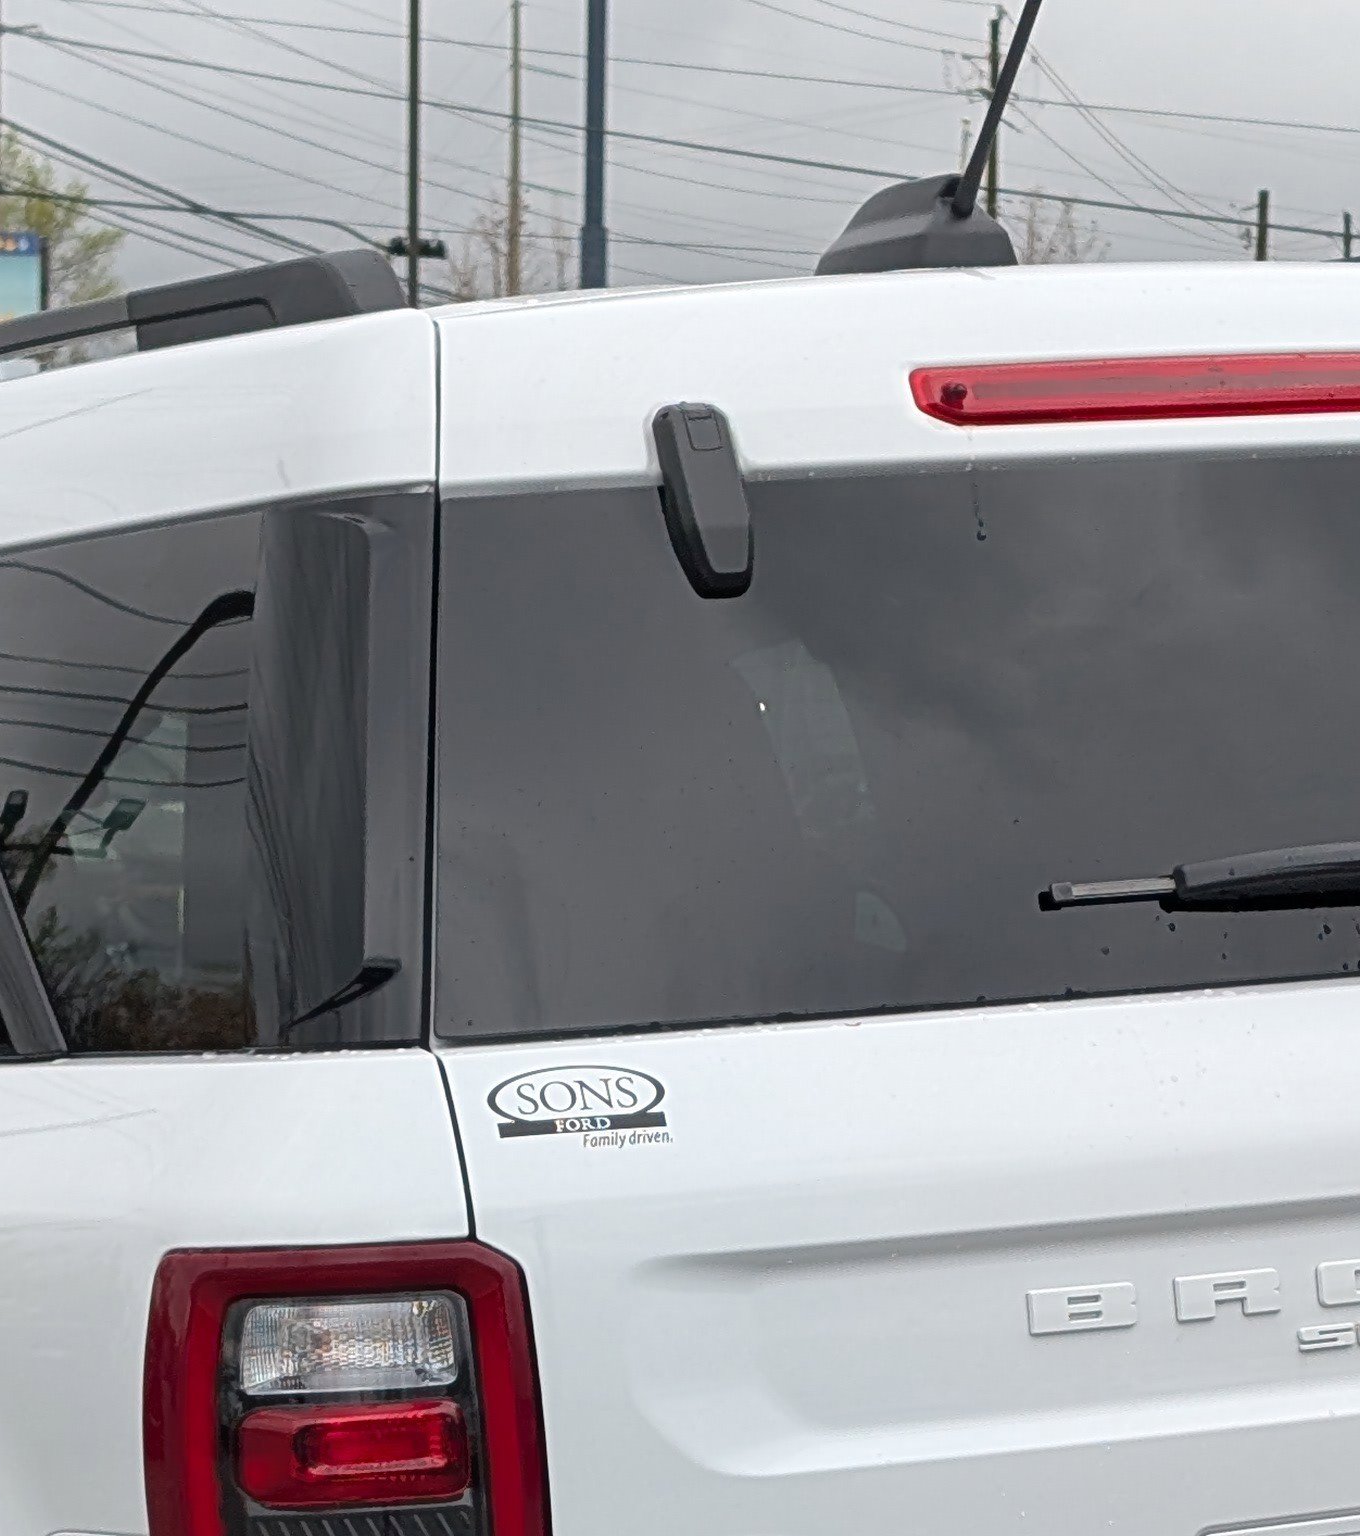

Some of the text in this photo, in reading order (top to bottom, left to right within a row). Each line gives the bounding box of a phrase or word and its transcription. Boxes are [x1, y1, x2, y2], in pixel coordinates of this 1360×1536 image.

[516, 1076, 638, 1115] SONS
[554, 1116, 611, 1133] FORD
[583, 1131, 626, 1148] Family
